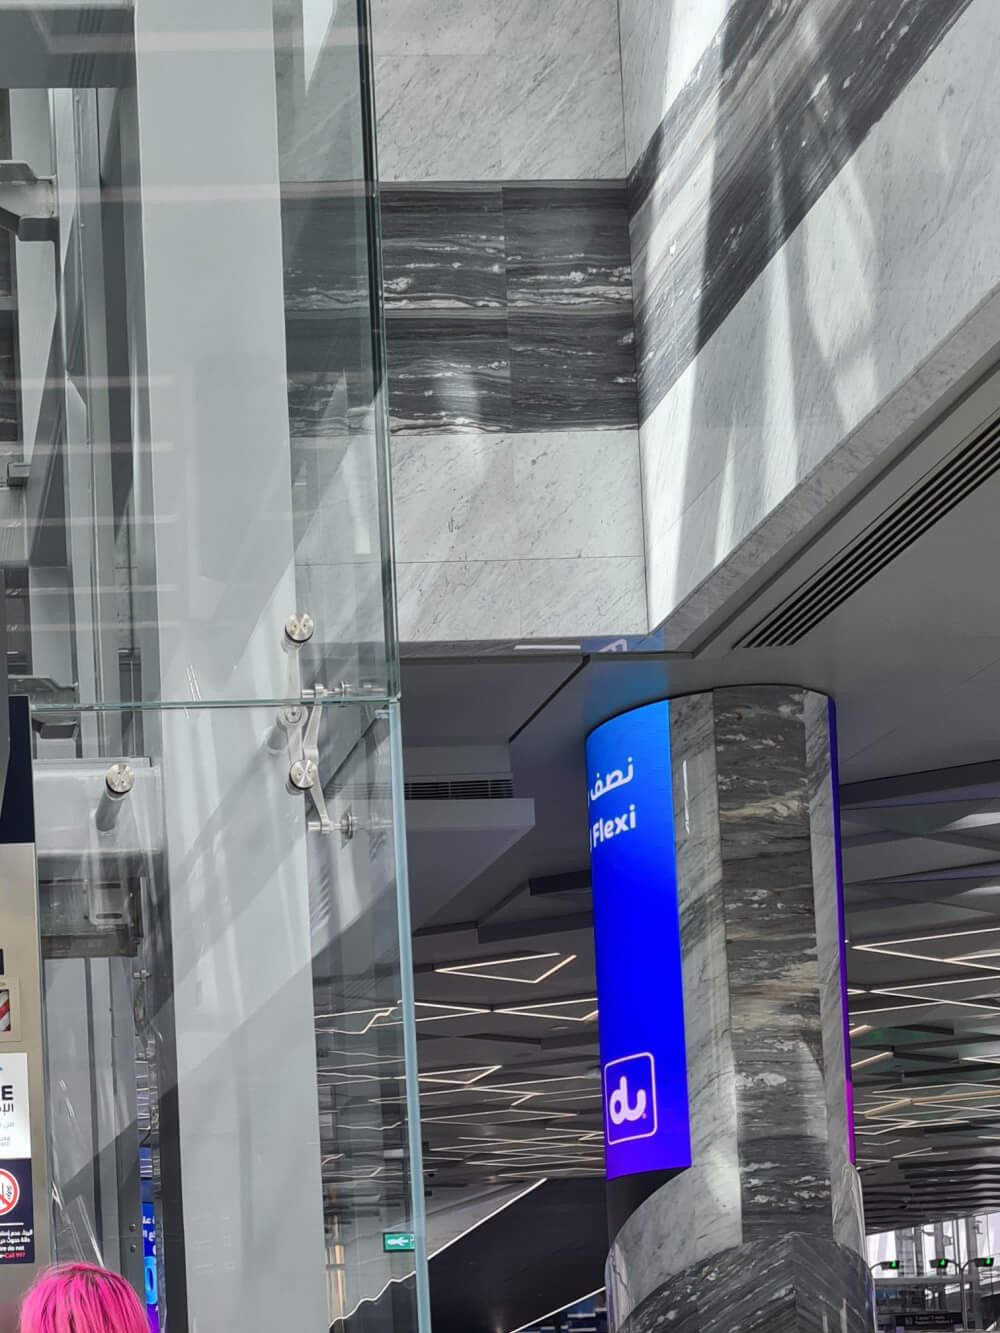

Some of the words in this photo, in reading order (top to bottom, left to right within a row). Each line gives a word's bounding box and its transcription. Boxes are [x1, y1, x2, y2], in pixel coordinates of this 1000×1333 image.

[590, 755, 635, 802] نصف
[592, 803, 637, 849] Flexi
[607, 1075, 647, 1124] du
